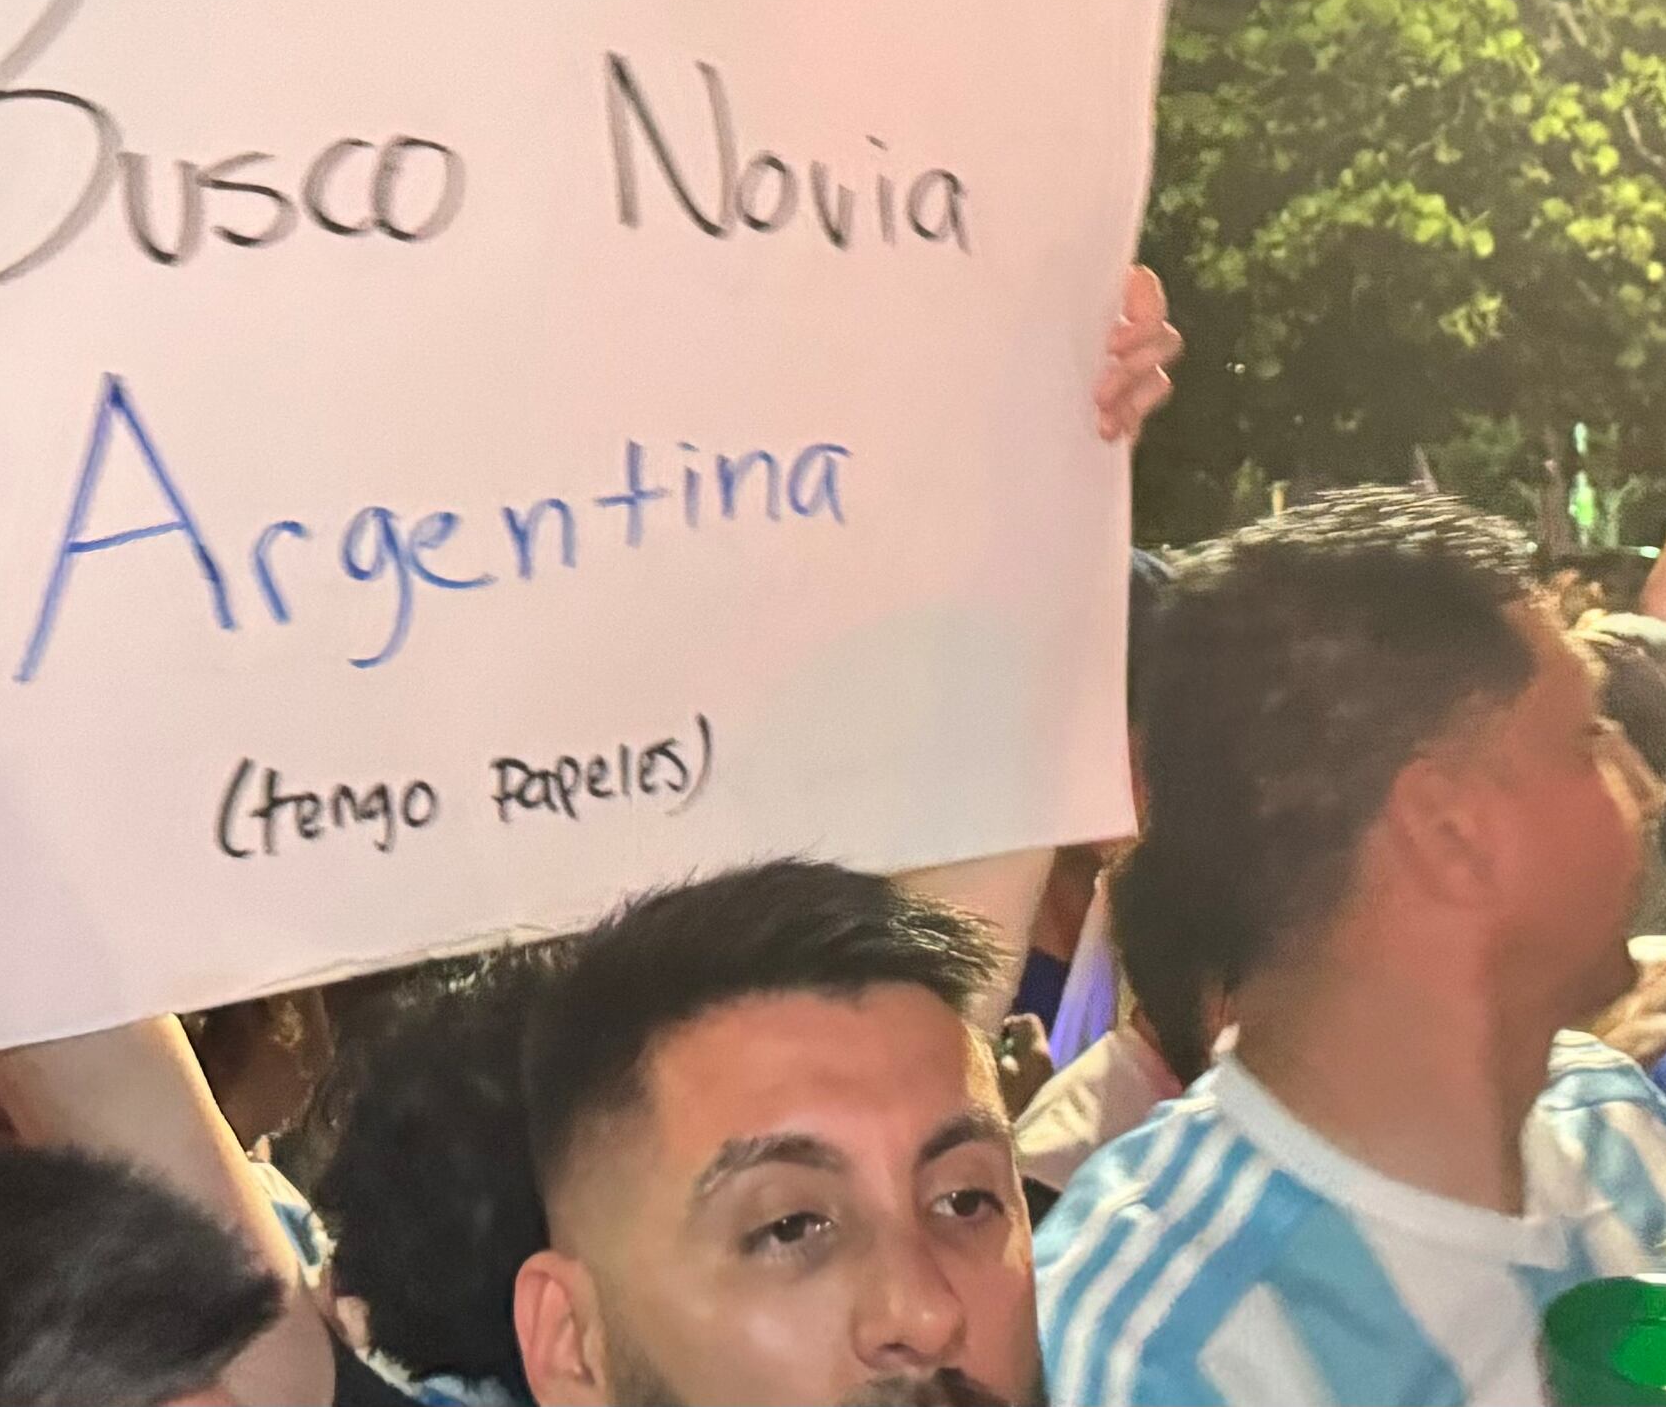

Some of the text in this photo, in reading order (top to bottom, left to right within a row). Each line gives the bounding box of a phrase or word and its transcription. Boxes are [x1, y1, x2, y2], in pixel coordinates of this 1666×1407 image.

[605, 51, 973, 252] Novia
[16, 373, 854, 685] Argentina
[217, 758, 439, 858] (tengo
